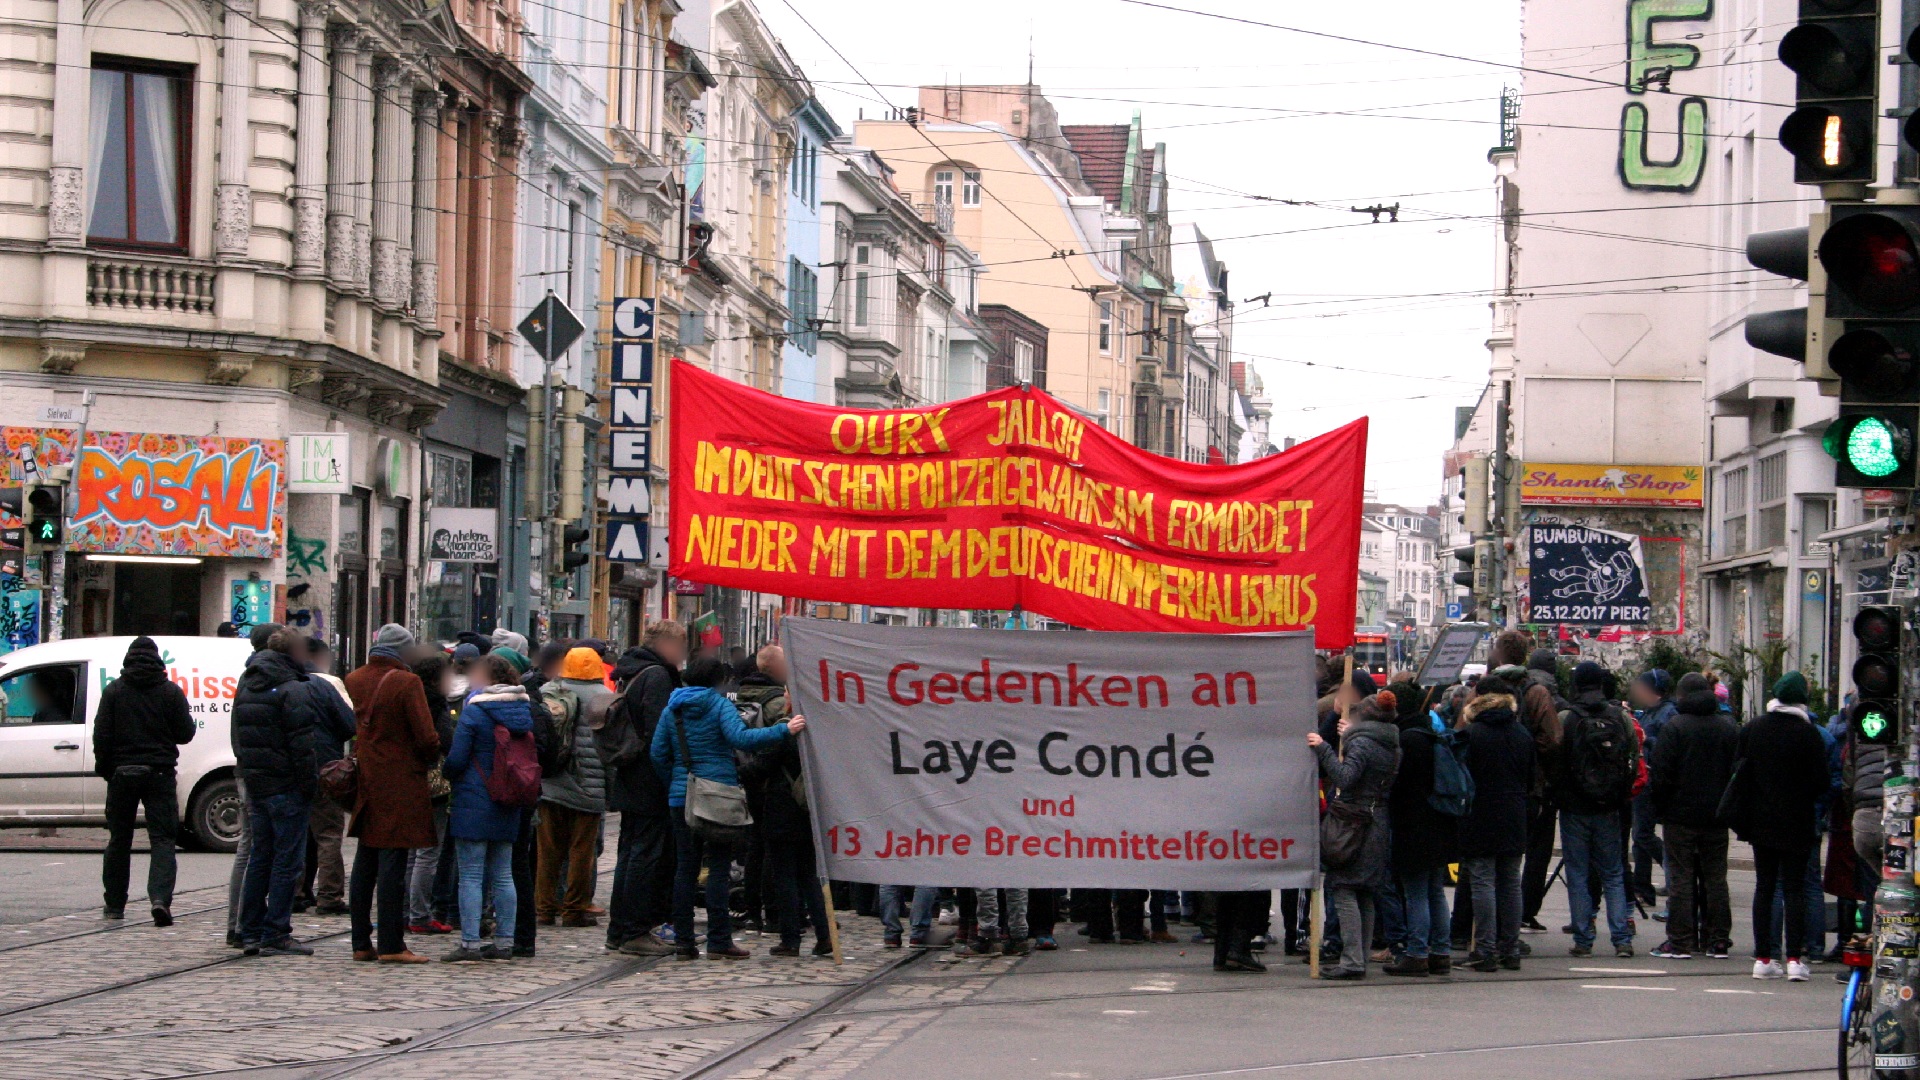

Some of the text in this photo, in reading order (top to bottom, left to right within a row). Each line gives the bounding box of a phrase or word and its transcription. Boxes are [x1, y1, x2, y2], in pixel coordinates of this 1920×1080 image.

[607, 298, 652, 560] CINEMA
[830, 399, 1085, 461] OURY JALLOH
[694, 441, 731, 494] IM
[1167, 499, 1314, 553] ERMORDET
[1522, 471, 1692, 495] Shanti Shop
[459, 529, 491, 542] helena
[684, 514, 798, 574] NIEDER
[808, 525, 877, 578] MIT
[886, 529, 961, 579] DEM
[1534, 605, 1607, 620] 25.12.2017
[1610, 606, 1640, 620] PIER
[818, 658, 1257, 708] In Gedenken an
[889, 731, 1215, 784] Laye Condé
[1022, 794, 1075, 817] und
[827, 825, 1295, 861] 13 Jahre Brechmittelfolter
